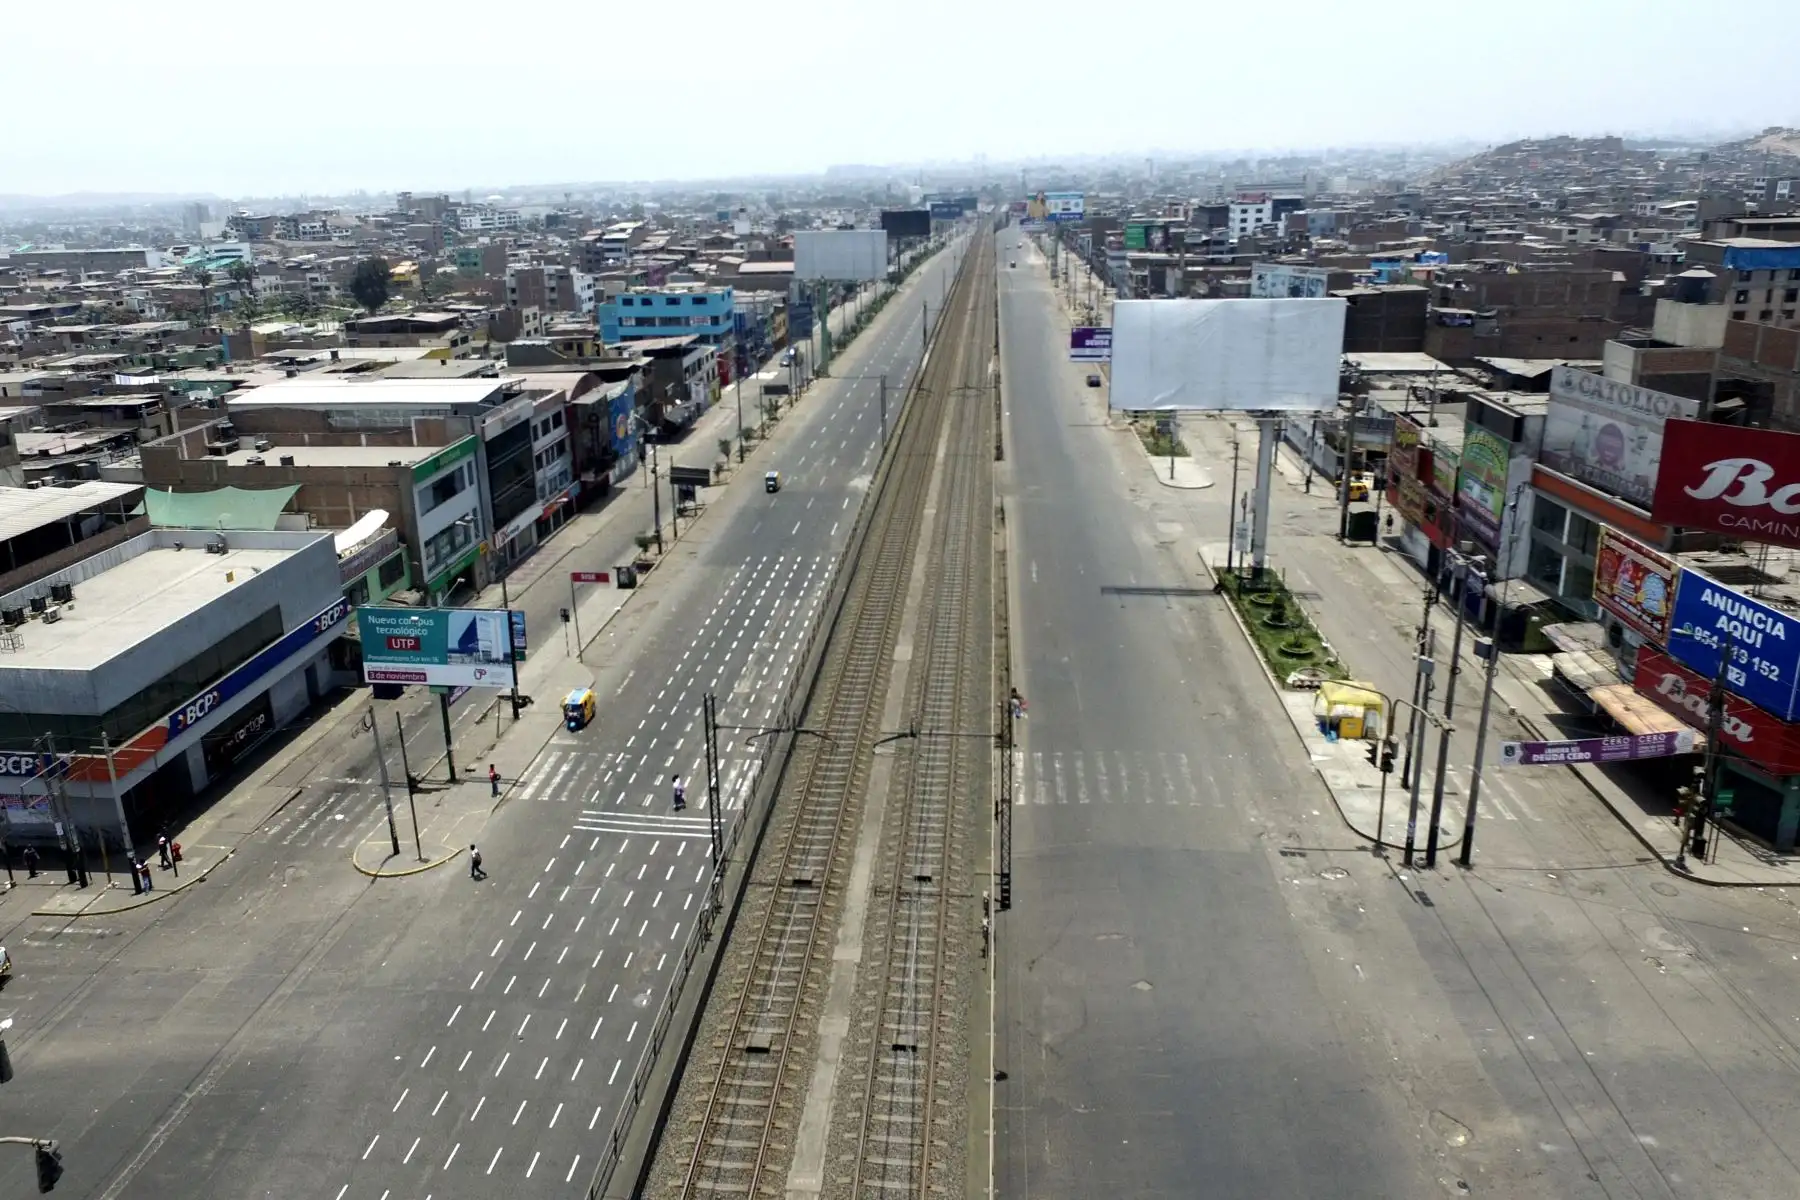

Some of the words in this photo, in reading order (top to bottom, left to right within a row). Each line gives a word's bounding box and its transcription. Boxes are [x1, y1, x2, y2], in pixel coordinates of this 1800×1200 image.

[1718, 513, 1800, 538] CAMIN
[321, 607, 340, 630] BCP
[368, 615, 396, 624] Nuevo
[1701, 588, 1785, 640] ANUNCIA
[376, 626, 428, 637] tecnológico
[1715, 615, 1763, 648] AQUI
[392, 638, 415, 649] UTP
[375, 672, 385, 680] de
[386, 673, 425, 681] noviembre
[1752, 656, 1780, 681] 152
[187, 694, 213, 724] BCP
[1655, 673, 1754, 742] Baa
[1602, 737, 1630, 746] CERO
[1638, 733, 1666, 743] CERO
[0, 756, 33, 774] BCP
